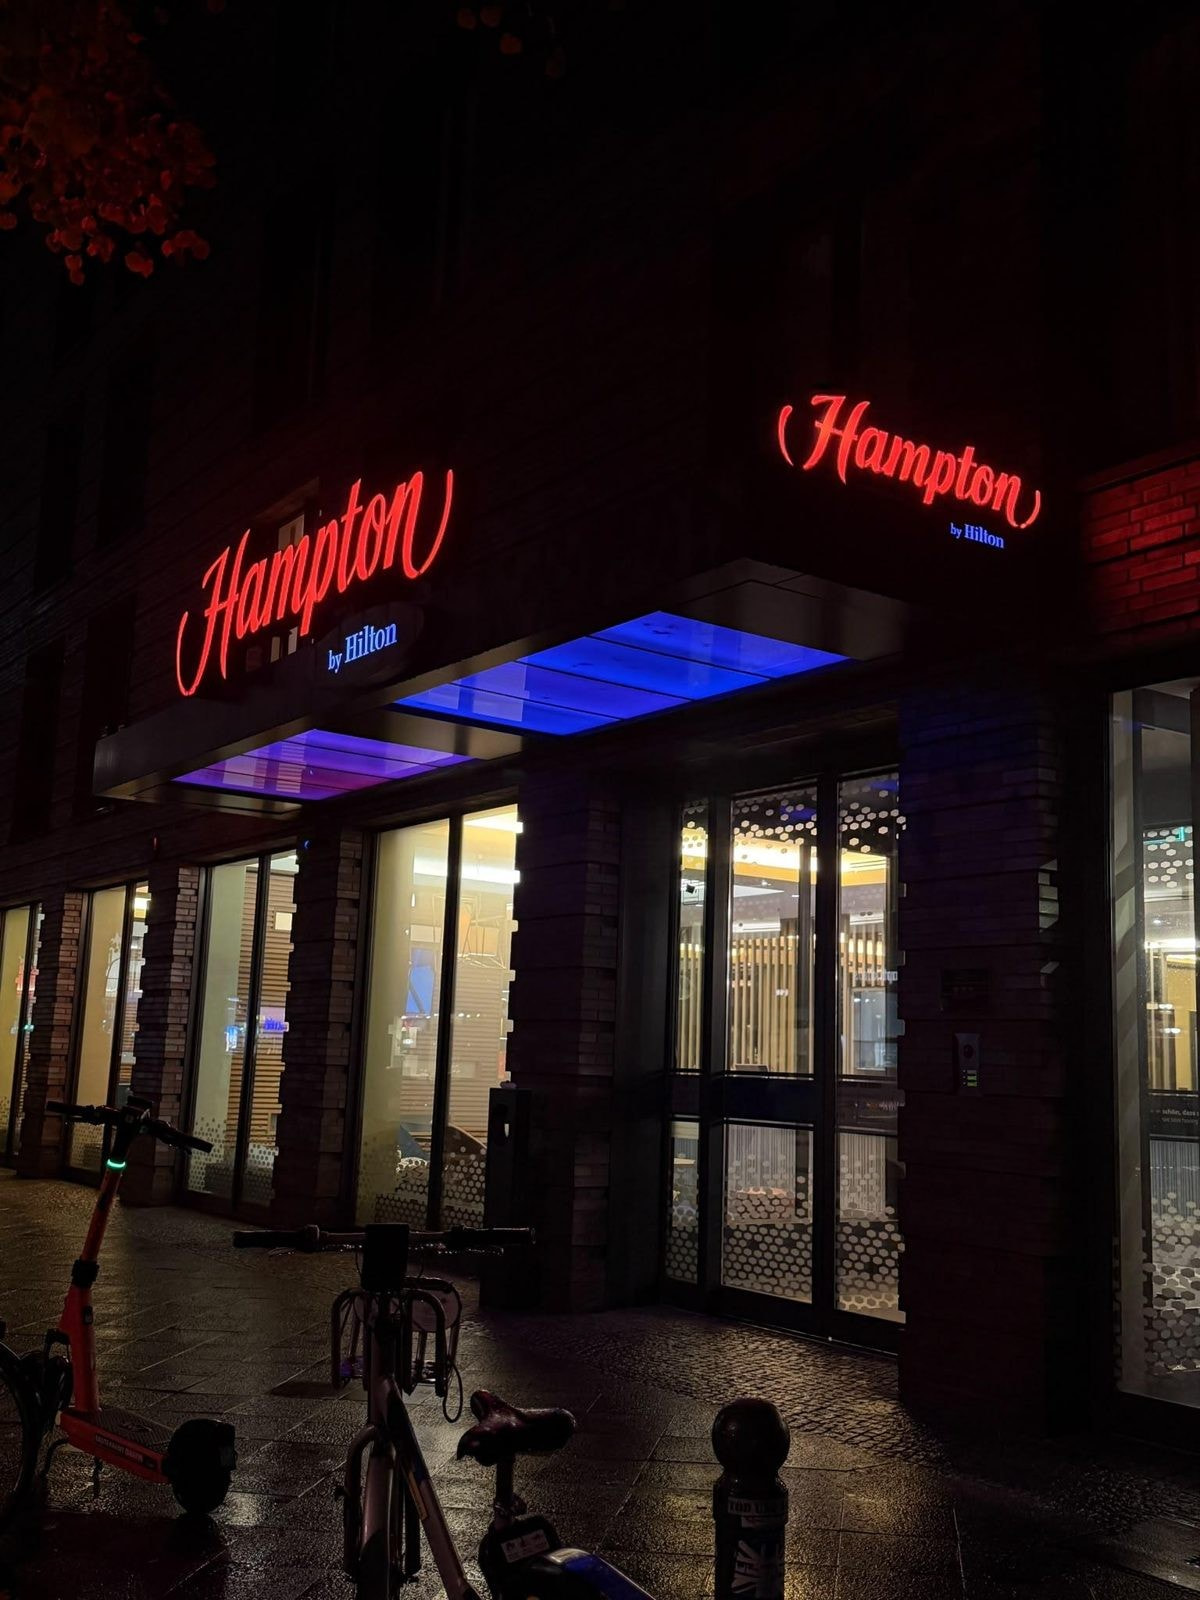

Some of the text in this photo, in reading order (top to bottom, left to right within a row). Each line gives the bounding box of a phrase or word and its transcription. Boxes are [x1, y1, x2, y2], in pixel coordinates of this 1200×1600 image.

[778, 394, 1041, 529] Hampton
[176, 468, 454, 696] Hampton
[949, 522, 1005, 549] by Hilton
[327, 623, 397, 674] by Hilton
